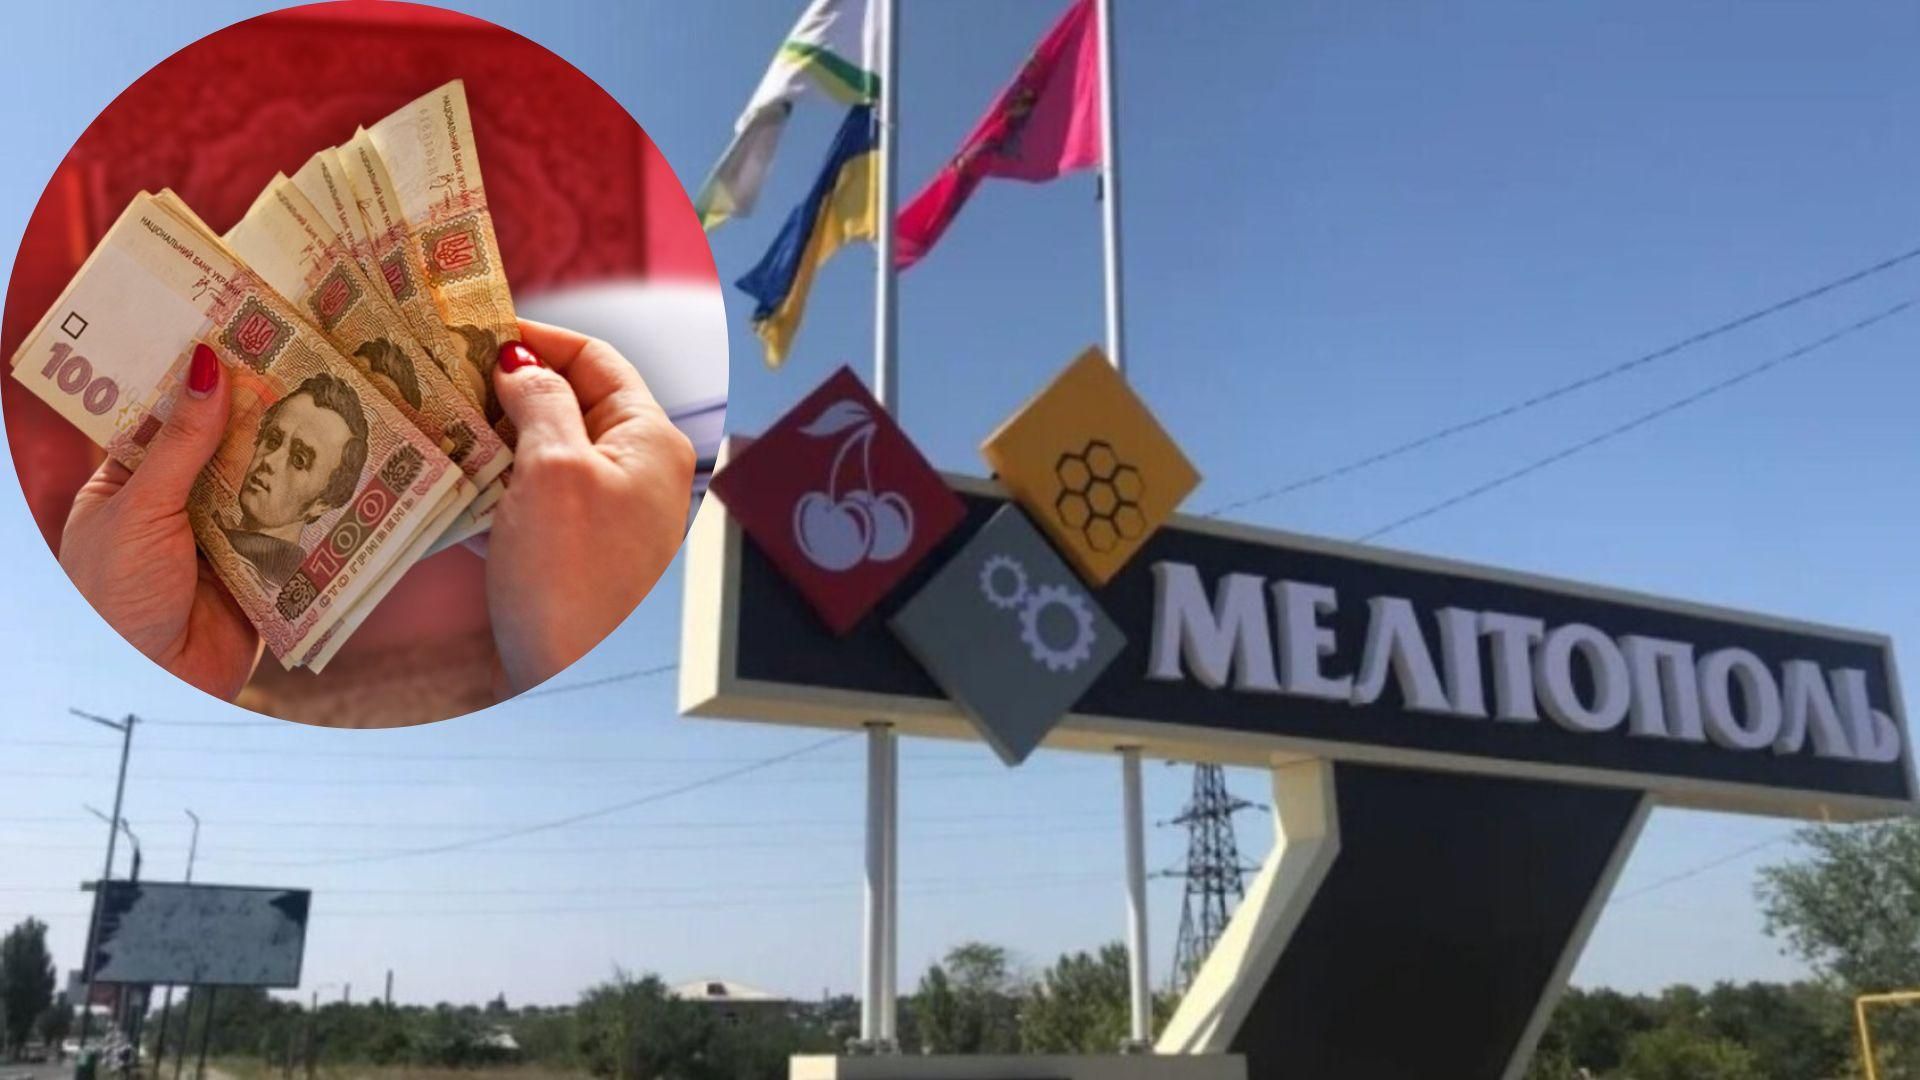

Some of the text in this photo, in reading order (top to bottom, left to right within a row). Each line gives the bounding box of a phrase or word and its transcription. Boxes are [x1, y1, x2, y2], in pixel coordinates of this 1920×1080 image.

[140, 216, 195, 261] НАЦІОНАЛЬНИЙ
[191, 256, 213, 275] БАНК
[40, 341, 120, 416] 100
[309, 488, 388, 578] 100
[319, 497, 414, 609] СТО ГРИВЕНЬ
[1146, 559, 1901, 763] МЕЛІТОПОЛЬ
